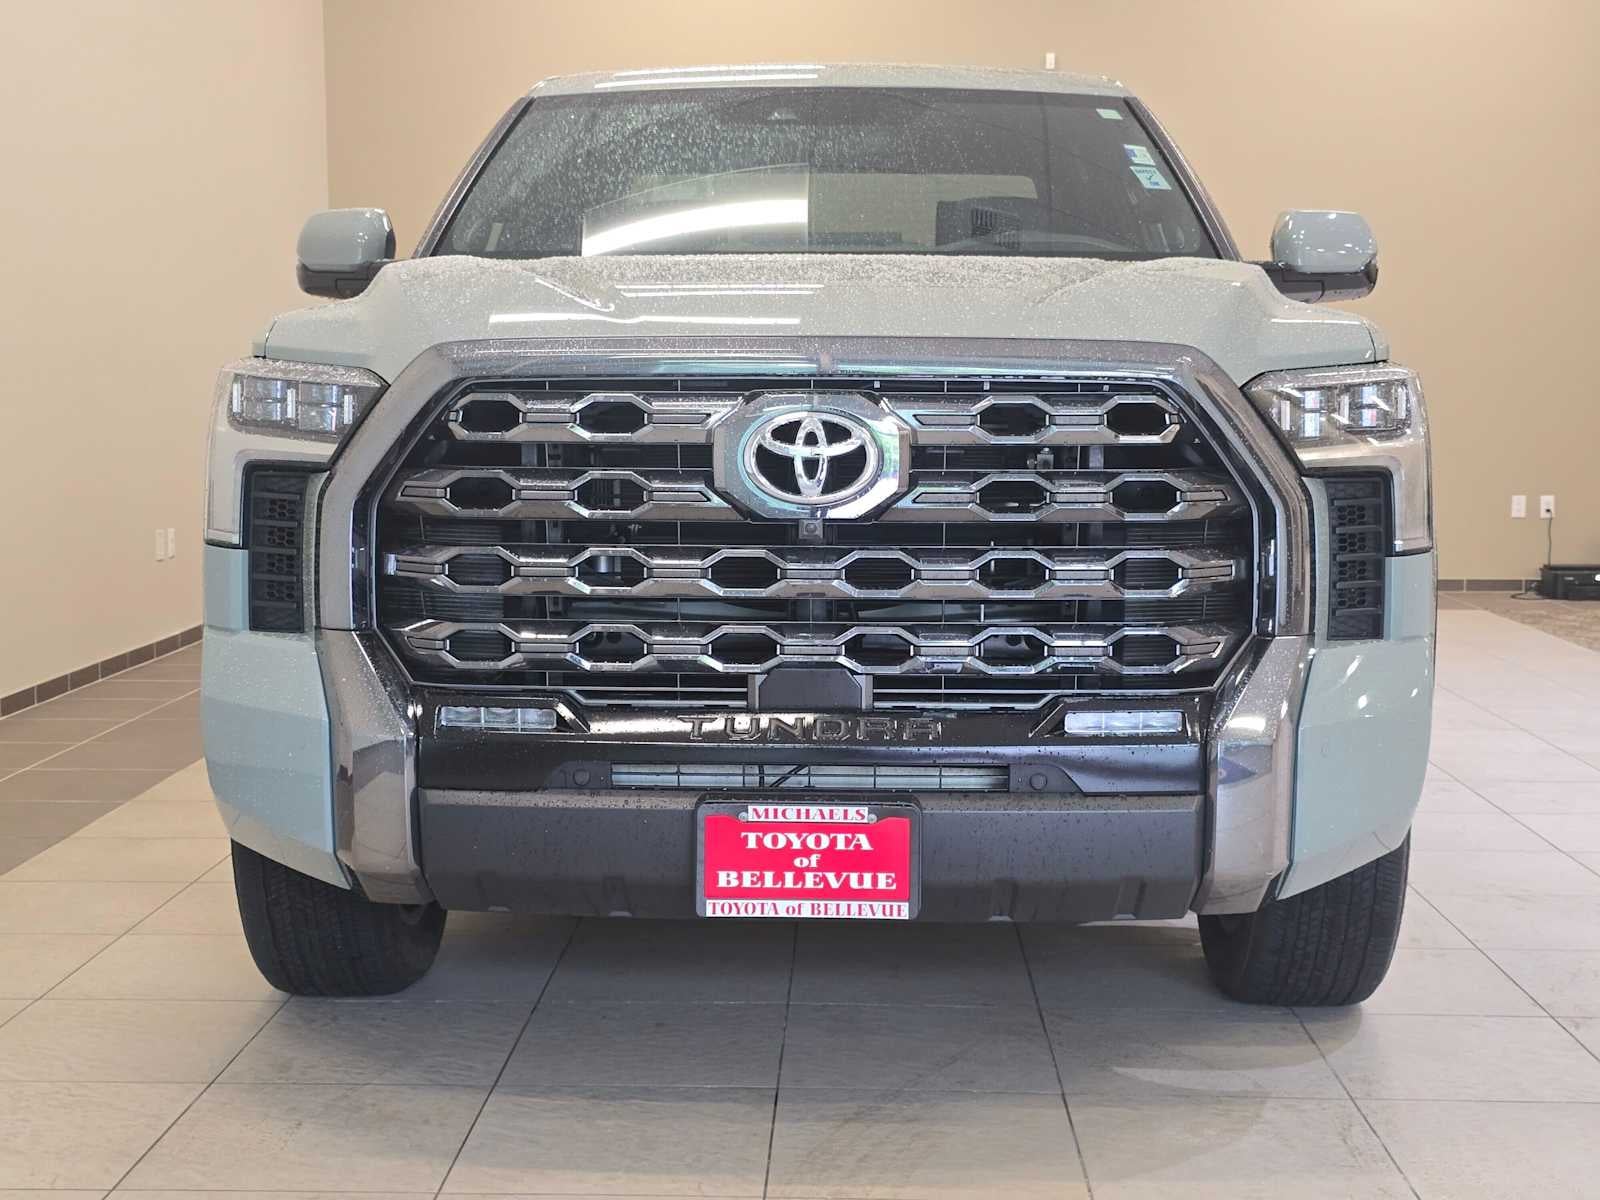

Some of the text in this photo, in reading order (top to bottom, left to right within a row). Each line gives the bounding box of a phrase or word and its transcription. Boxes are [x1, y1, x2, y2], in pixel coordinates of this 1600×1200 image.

[679, 715, 942, 740] TUNDRA
[751, 807, 866, 821] MICHAELS
[740, 832, 874, 850] TOYOTA
[793, 854, 821, 868] of
[716, 870, 897, 890] BELLEVUE
[708, 902, 908, 918] TOYOTA of BELLEVUE
